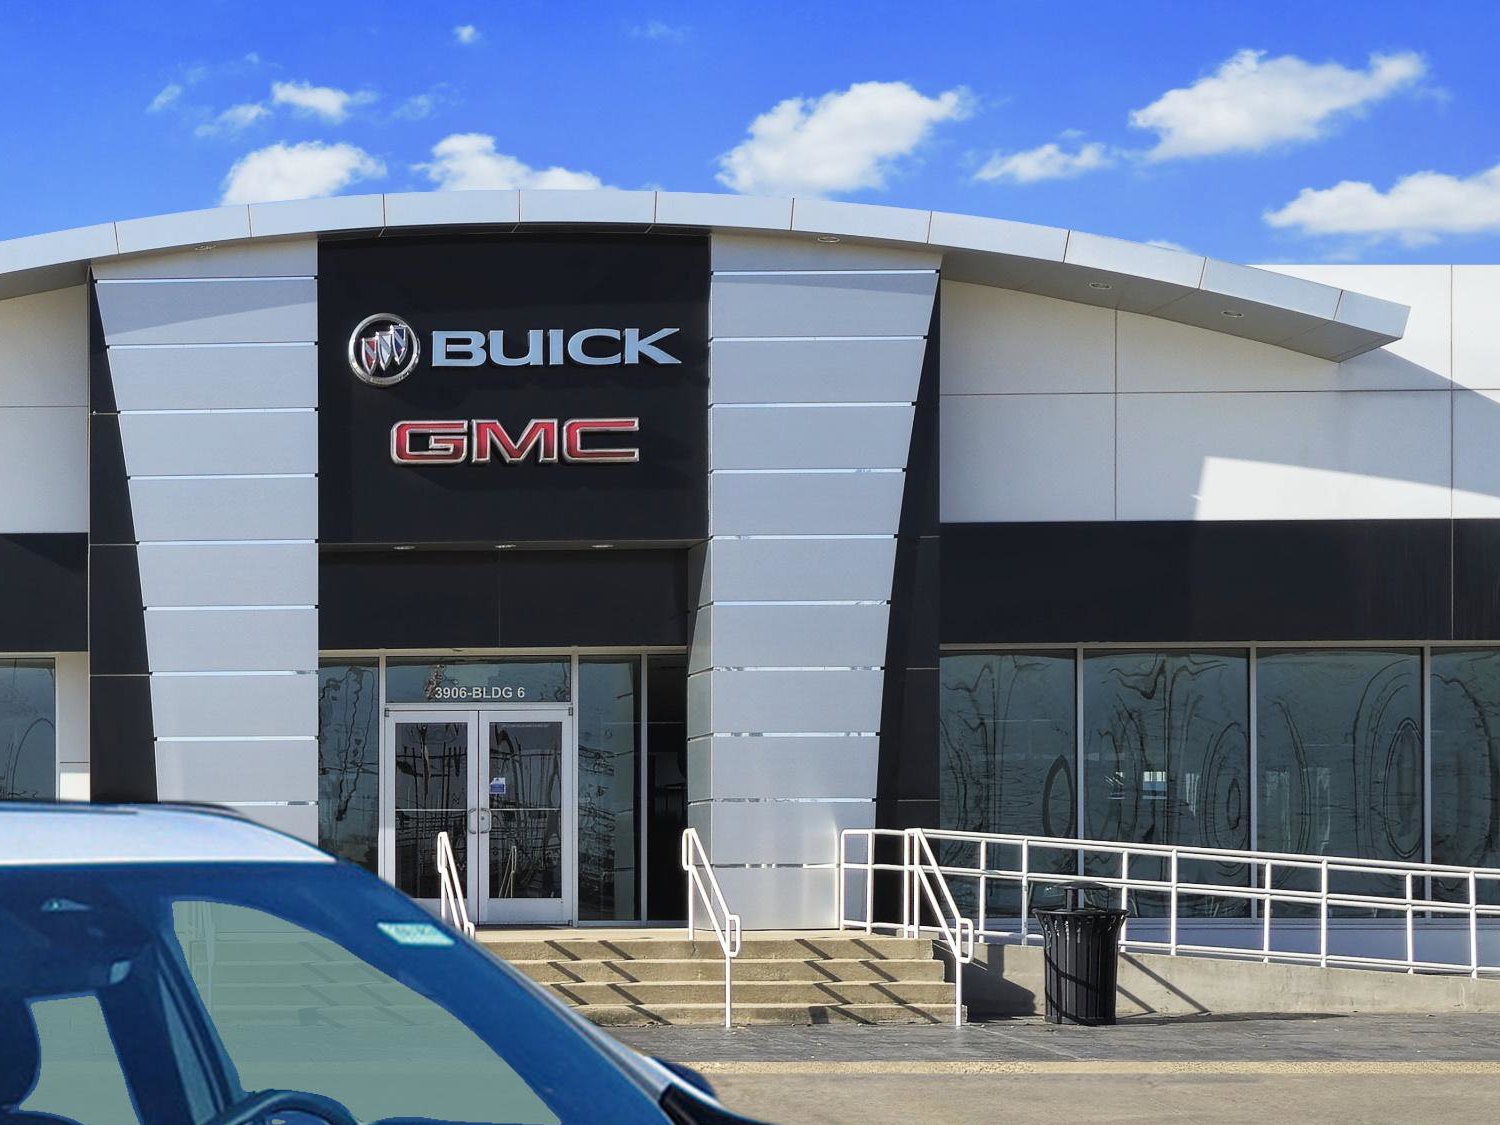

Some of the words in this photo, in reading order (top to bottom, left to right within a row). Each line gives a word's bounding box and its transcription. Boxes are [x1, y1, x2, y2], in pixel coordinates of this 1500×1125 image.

[431, 327, 683, 368] BUICK
[390, 416, 640, 465] GMC
[434, 686, 513, 699] 3906-BLDG
[517, 686, 526, 698] 6
